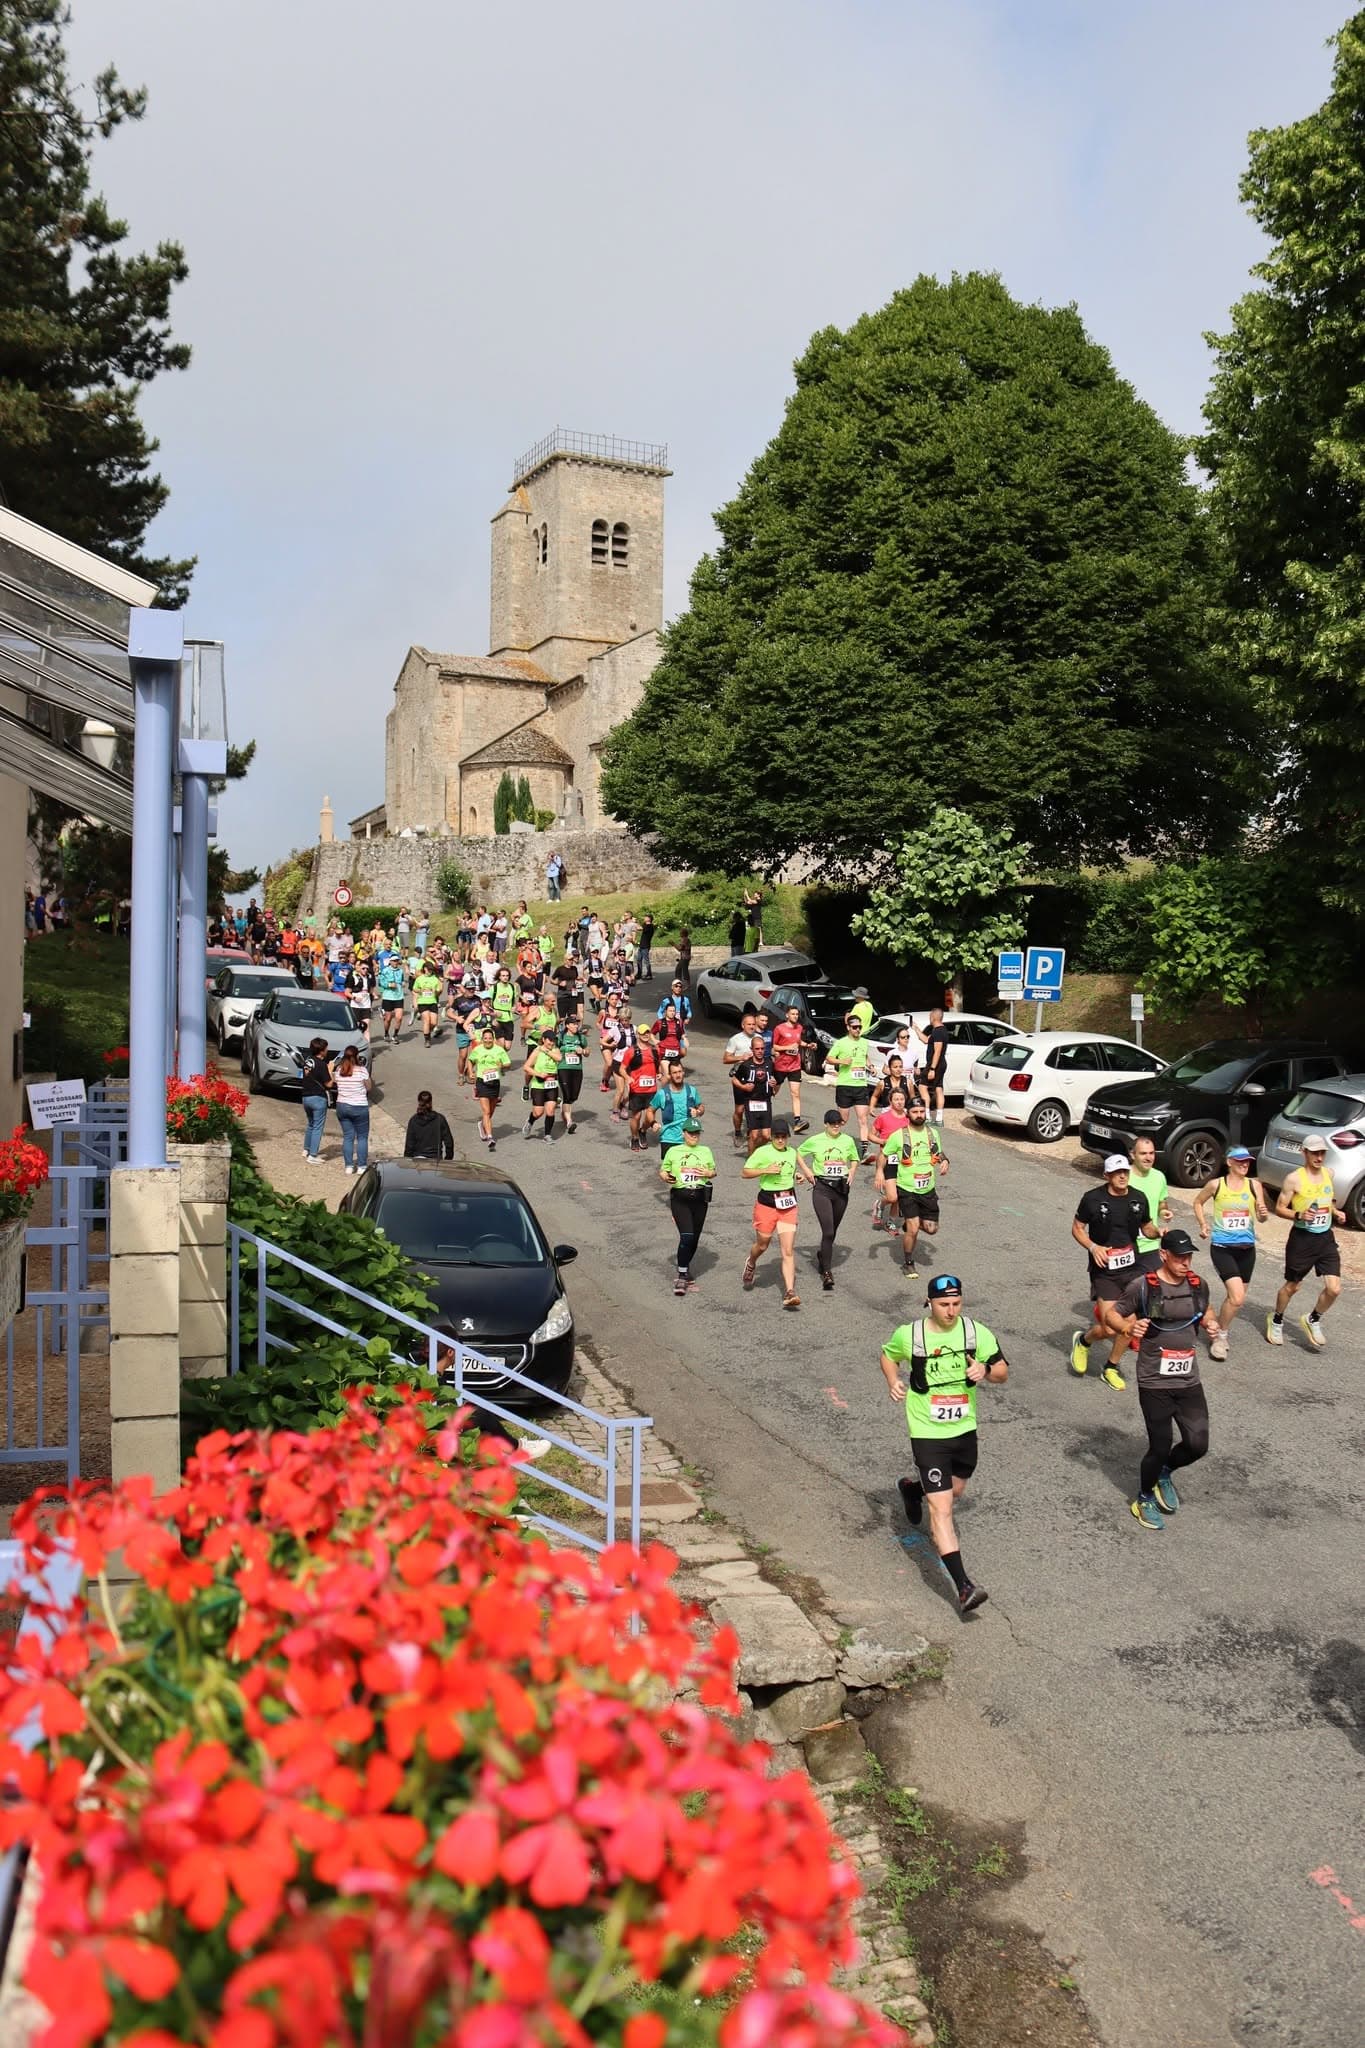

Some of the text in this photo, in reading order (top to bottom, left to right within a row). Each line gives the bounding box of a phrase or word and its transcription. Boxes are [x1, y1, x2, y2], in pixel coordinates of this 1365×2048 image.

[1036, 955, 1054, 980] P
[827, 1166, 842, 1175] 215
[1228, 1218, 1246, 1228] 274
[1114, 1254, 1131, 1266] 162
[1168, 1361, 1189, 1372] 230
[937, 1407, 962, 1420] 214
